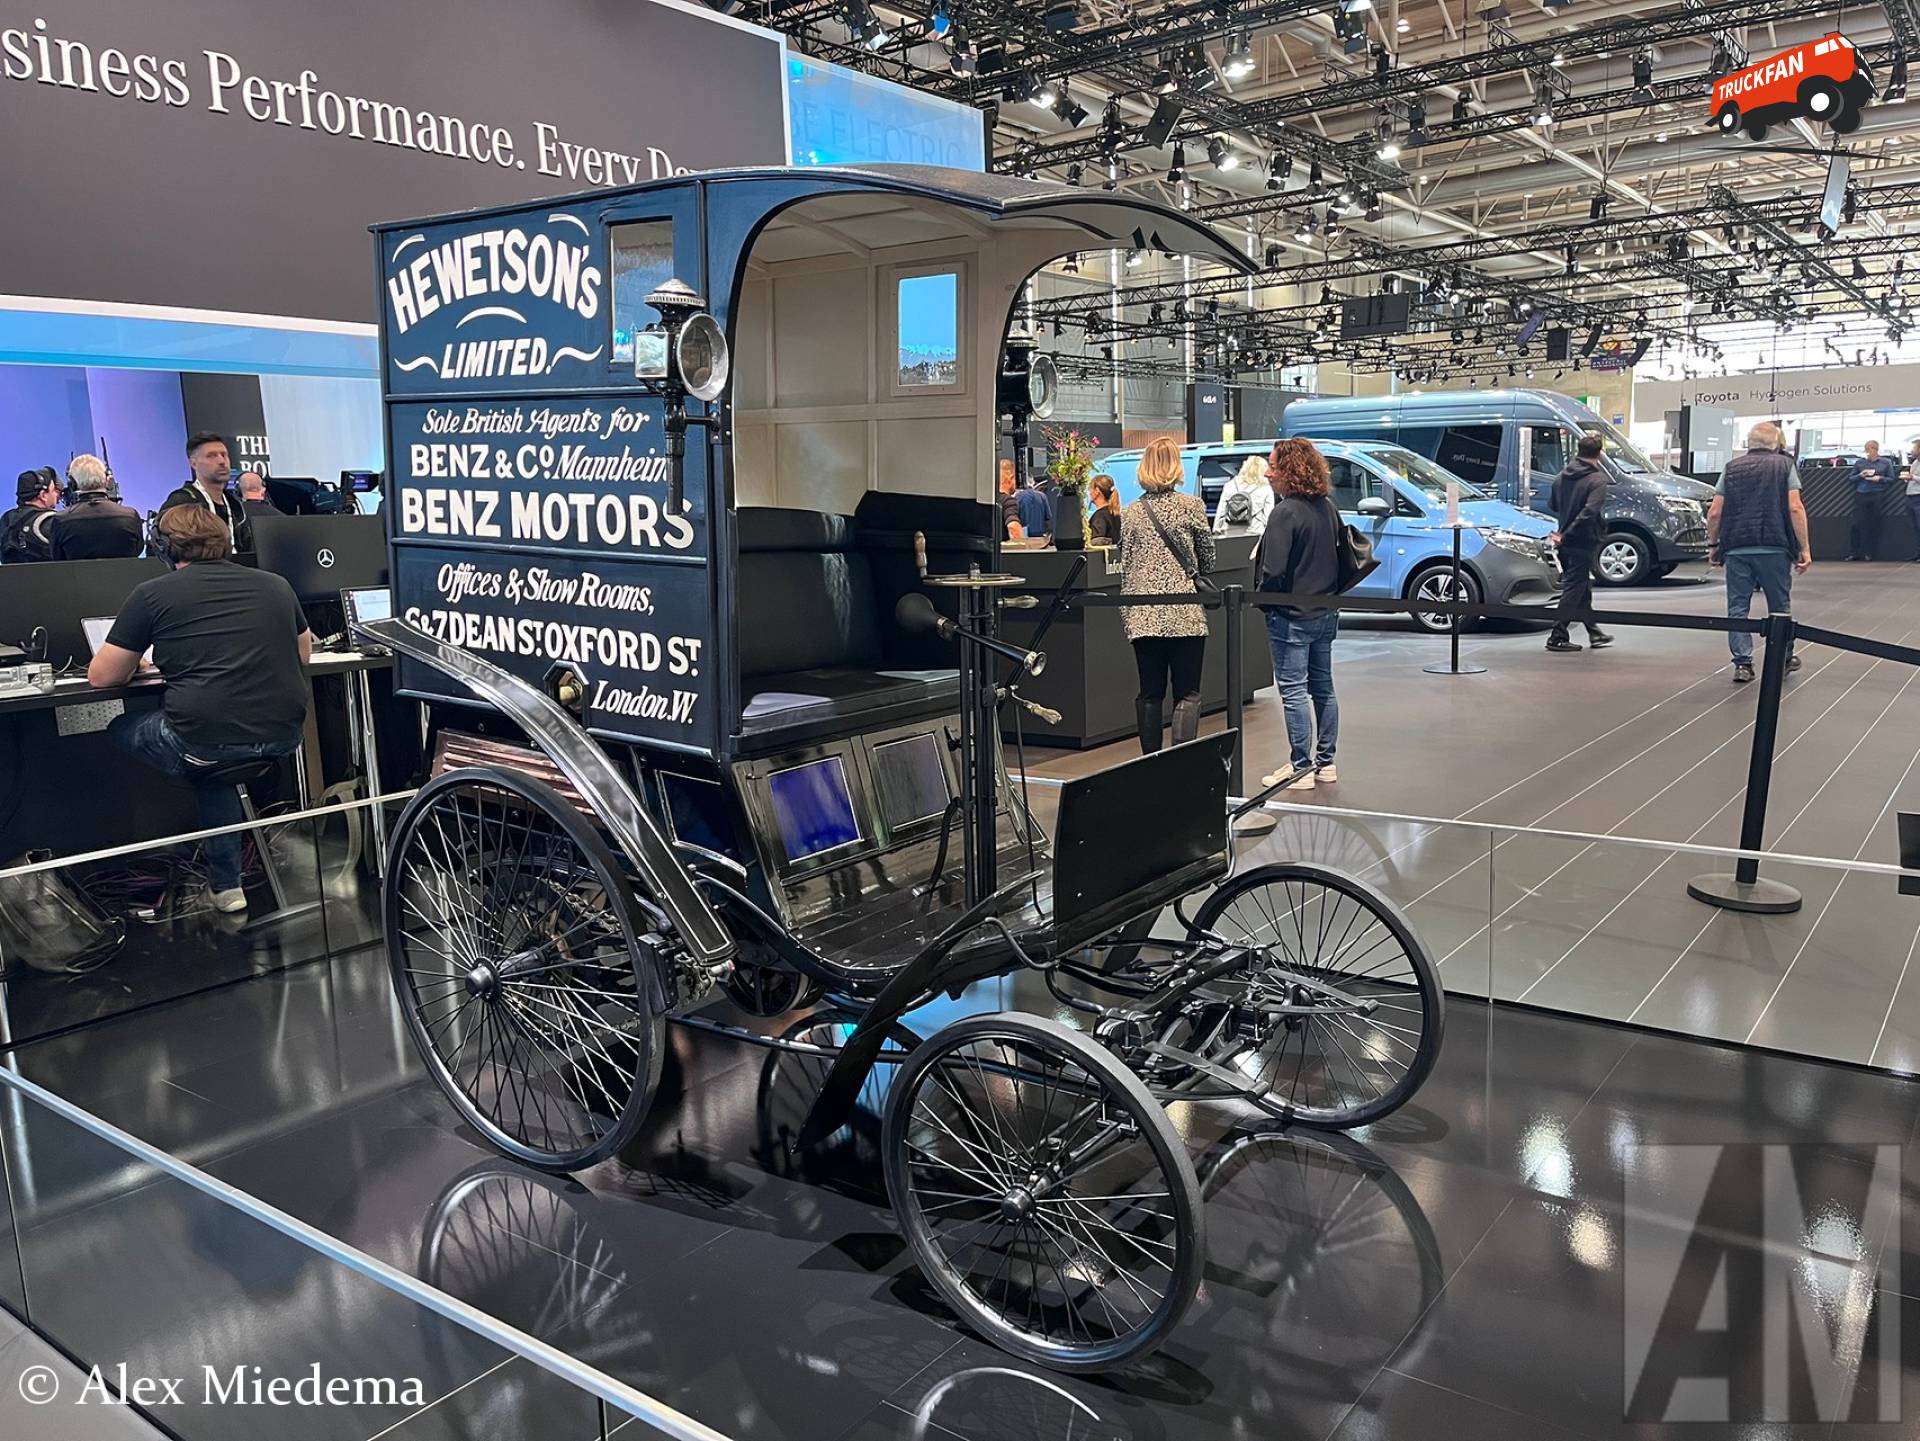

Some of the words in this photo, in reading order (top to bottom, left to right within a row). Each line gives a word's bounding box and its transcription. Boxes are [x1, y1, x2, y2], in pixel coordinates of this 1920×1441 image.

[0, 18, 190, 107] siness
[203, 50, 525, 170] Performance.
[388, 228, 601, 335] HEWETSON'S
[440, 337, 551, 379] LIMITED.
[1696, 392, 1740, 404] Toyota
[1814, 384, 1872, 396] Solutions
[422, 408, 460, 434] Sole
[459, 407, 523, 434] British
[525, 407, 601, 439] Agents
[600, 406, 650, 440] for
[410, 444, 491, 478] BENZ
[495, 449, 515, 479] &
[402, 488, 501, 537] BENZ
[510, 491, 695, 549] MOTORS
[437, 562, 502, 604] Offices
[504, 567, 524, 606] &
[523, 567, 578, 601] Show
[575, 571, 655, 616] Rooms,
[544, 621, 662, 672] OXFORD
